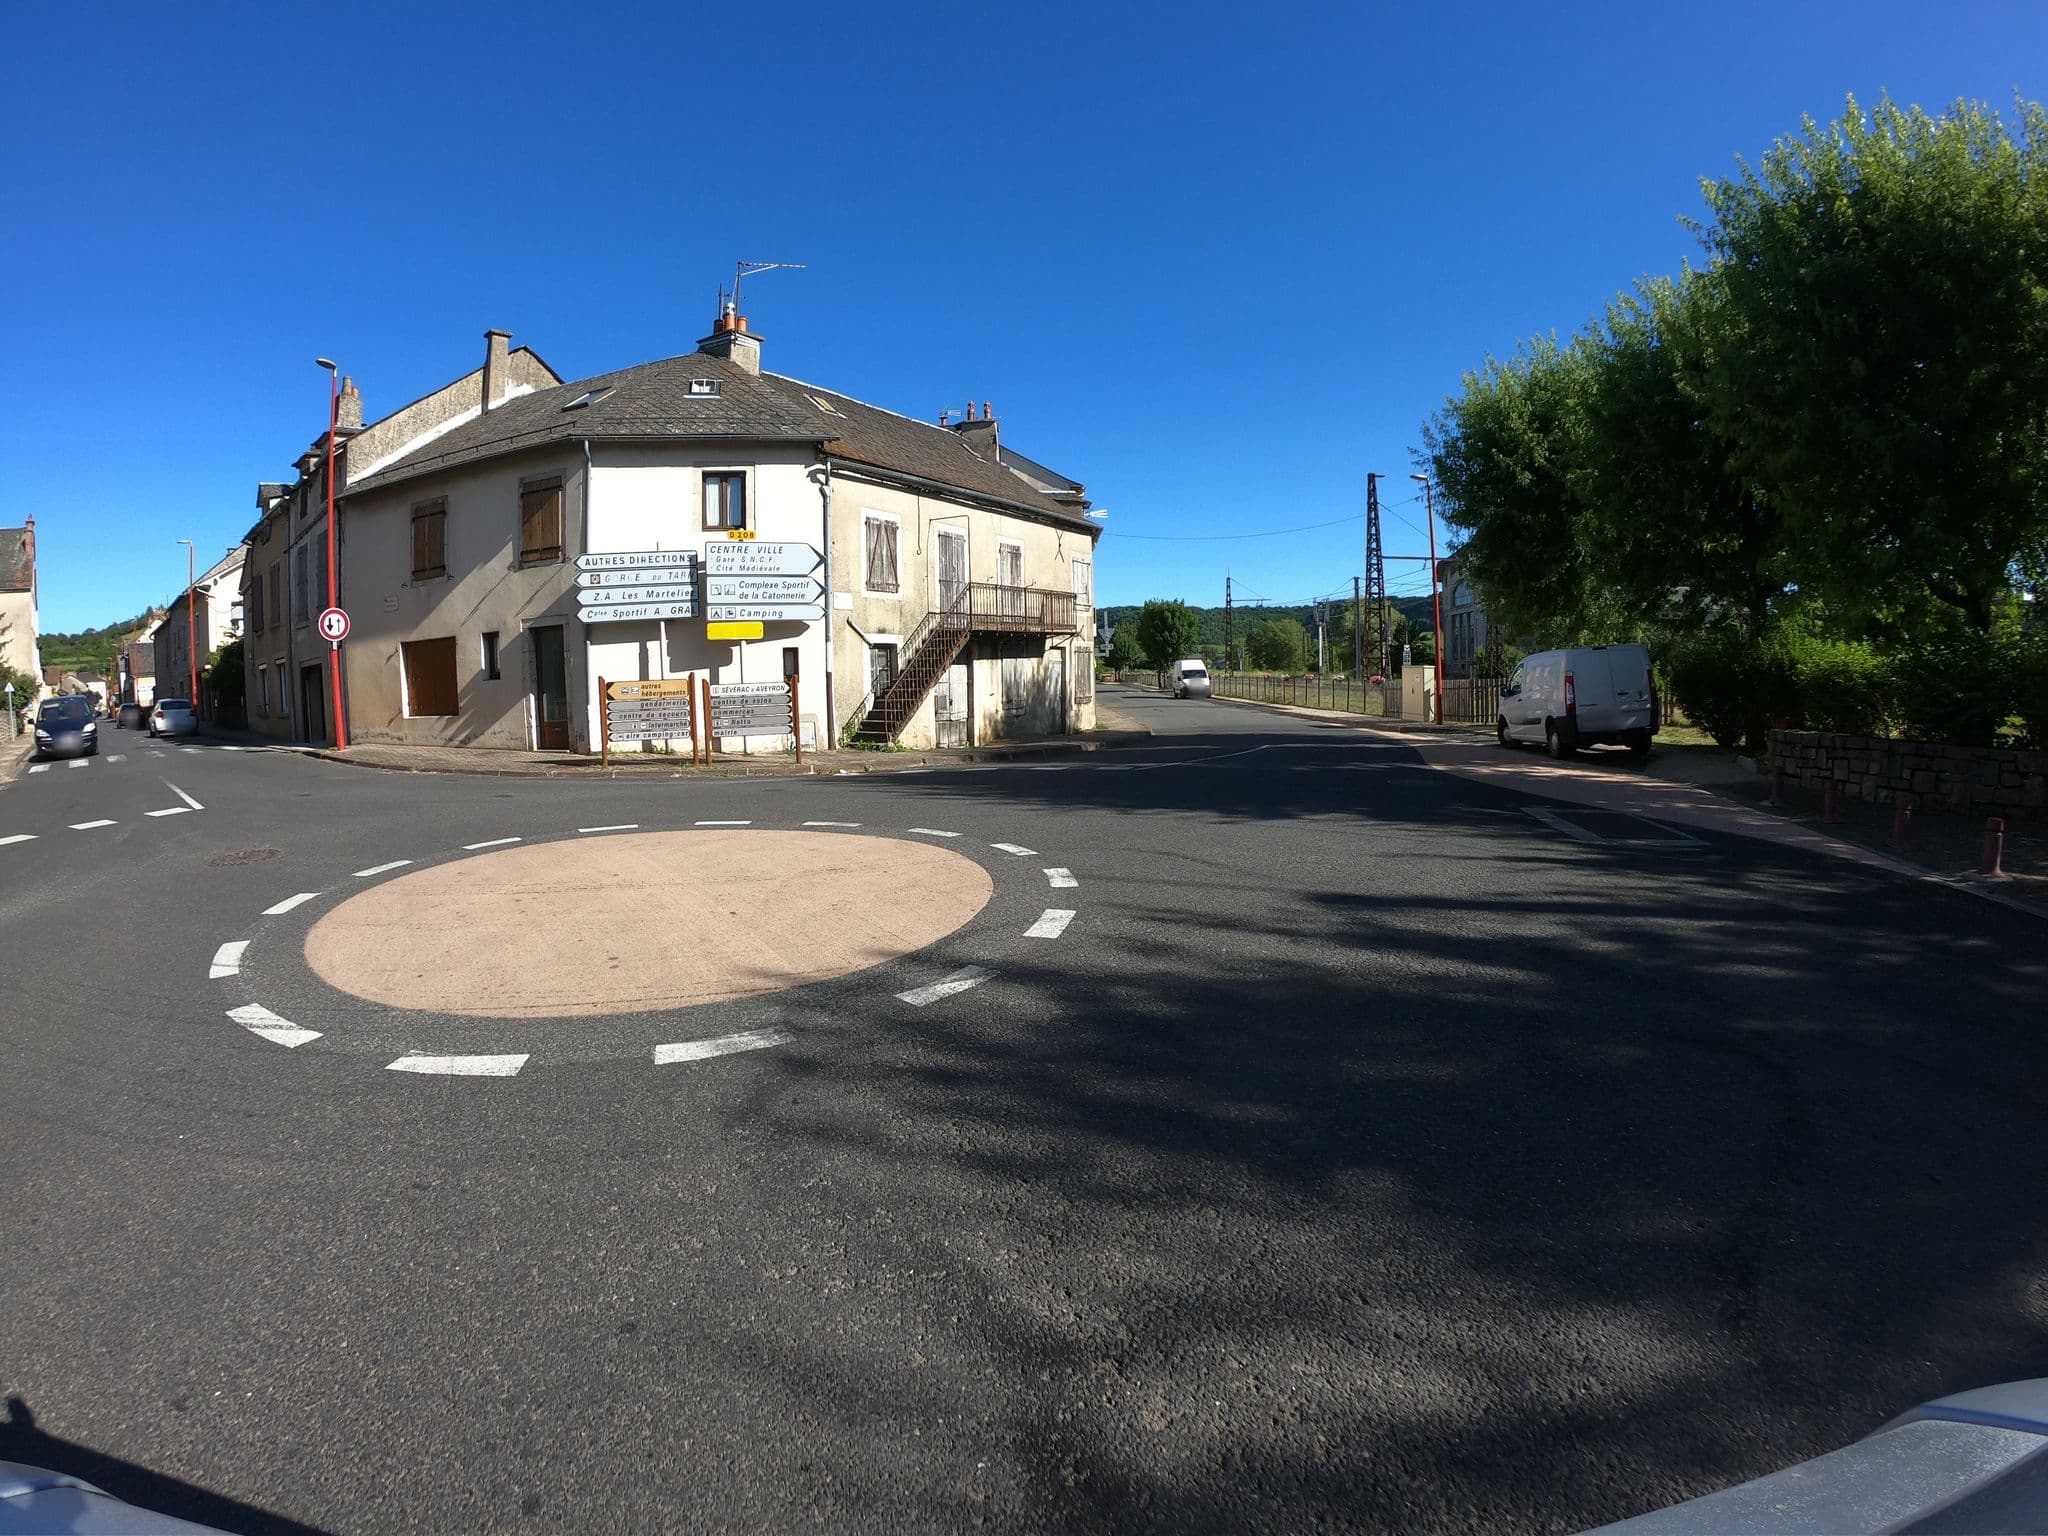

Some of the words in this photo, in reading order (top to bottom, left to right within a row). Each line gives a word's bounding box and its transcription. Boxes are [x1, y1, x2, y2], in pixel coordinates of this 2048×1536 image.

[710, 545, 750, 554] CENTRE
[757, 546, 784, 554] VILLE
[585, 556, 625, 566] AUTRES
[629, 554, 693, 564] DIRECTIONS
[738, 580, 779, 591] Complexe
[781, 580, 810, 590] Sportif
[593, 593, 614, 601] Z.A.
[622, 591, 639, 600] Les
[738, 592, 749, 600] de
[751, 592, 759, 600] la
[761, 592, 806, 600] Catonnerie
[612, 608, 647, 619] Sportif
[739, 609, 784, 619] Camping
[640, 700, 687, 709] gendarmerie
